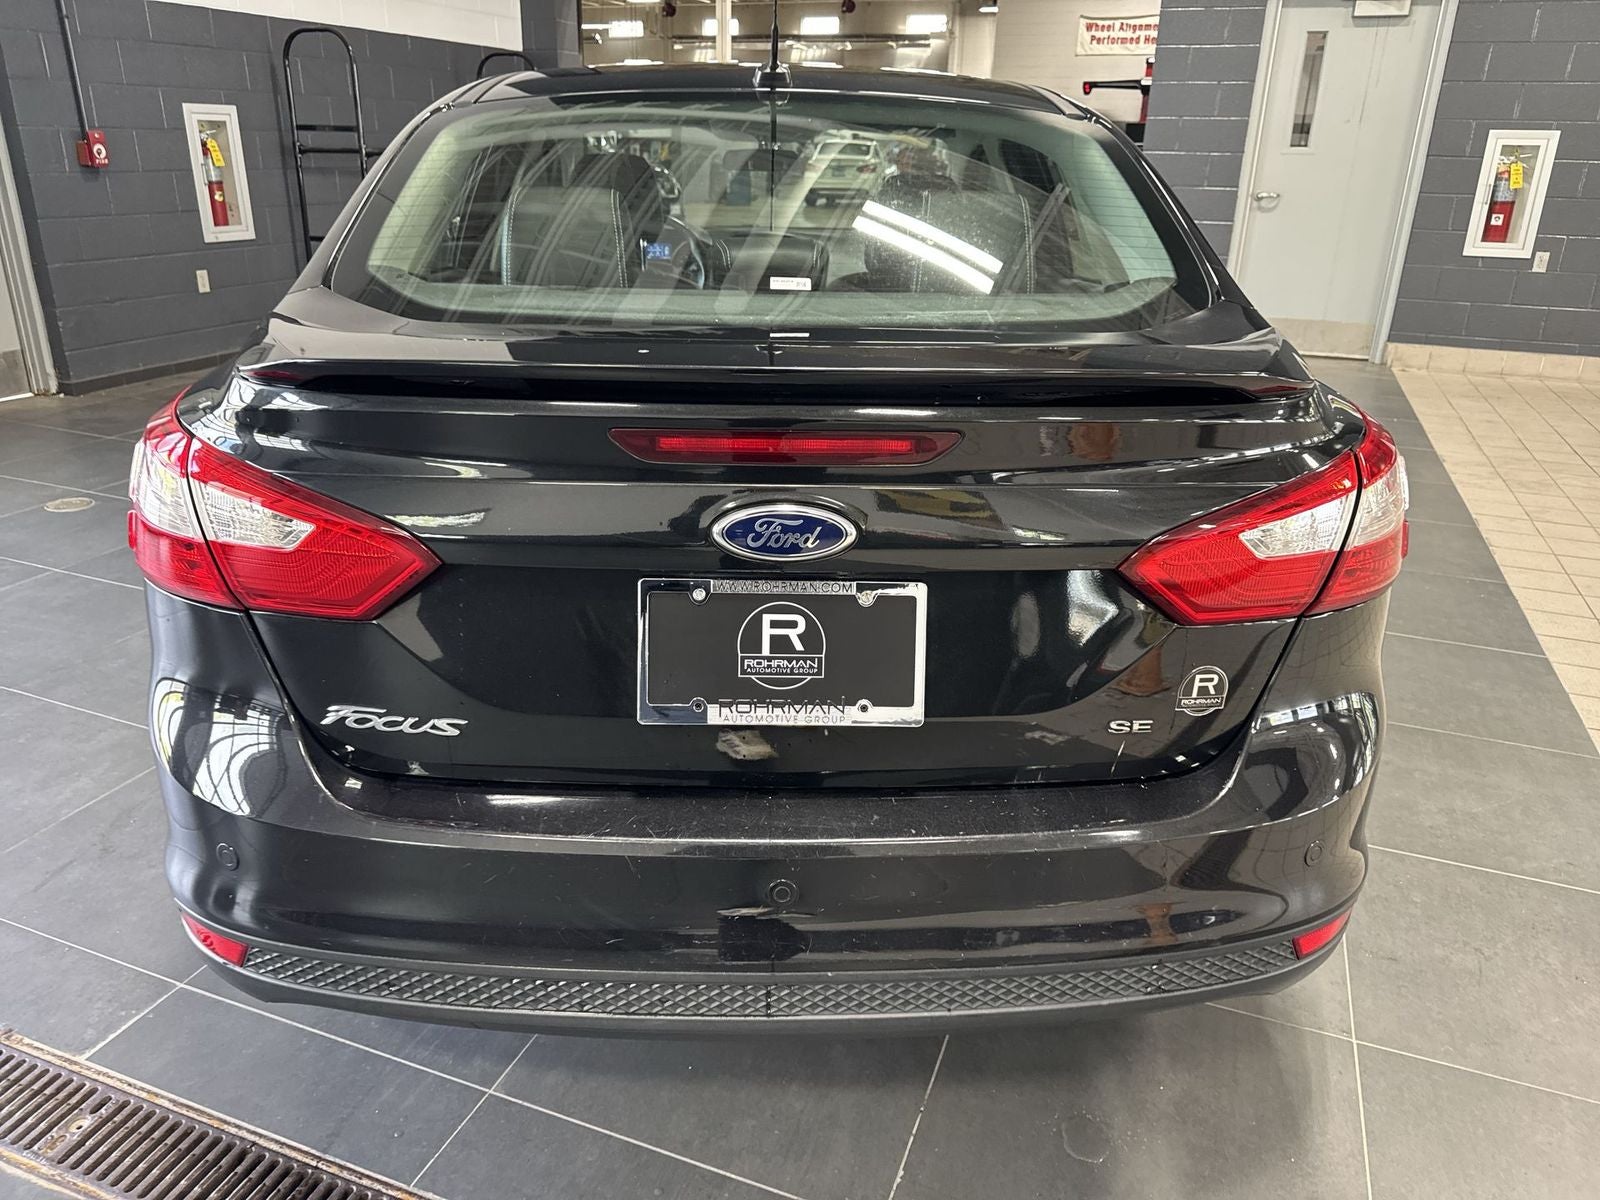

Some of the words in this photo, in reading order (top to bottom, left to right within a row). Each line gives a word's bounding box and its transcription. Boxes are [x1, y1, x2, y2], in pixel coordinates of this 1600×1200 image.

[1086, 22, 1115, 32] Wheel
[1090, 35, 1141, 45] Performed
[747, 517, 823, 549] Ford
[716, 581, 853, 594] WWW.ROHRMAN.COM
[761, 613, 807, 655] R
[744, 658, 818, 670] ROHRMAN
[1191, 673, 1220, 698] R
[718, 696, 846, 717] ROHRMAN
[1180, 697, 1222, 707] ROHRMAN
[723, 715, 798, 724] AUTOMOTIVE
[804, 715, 846, 724] GROUP
[1107, 719, 1154, 734] SE
